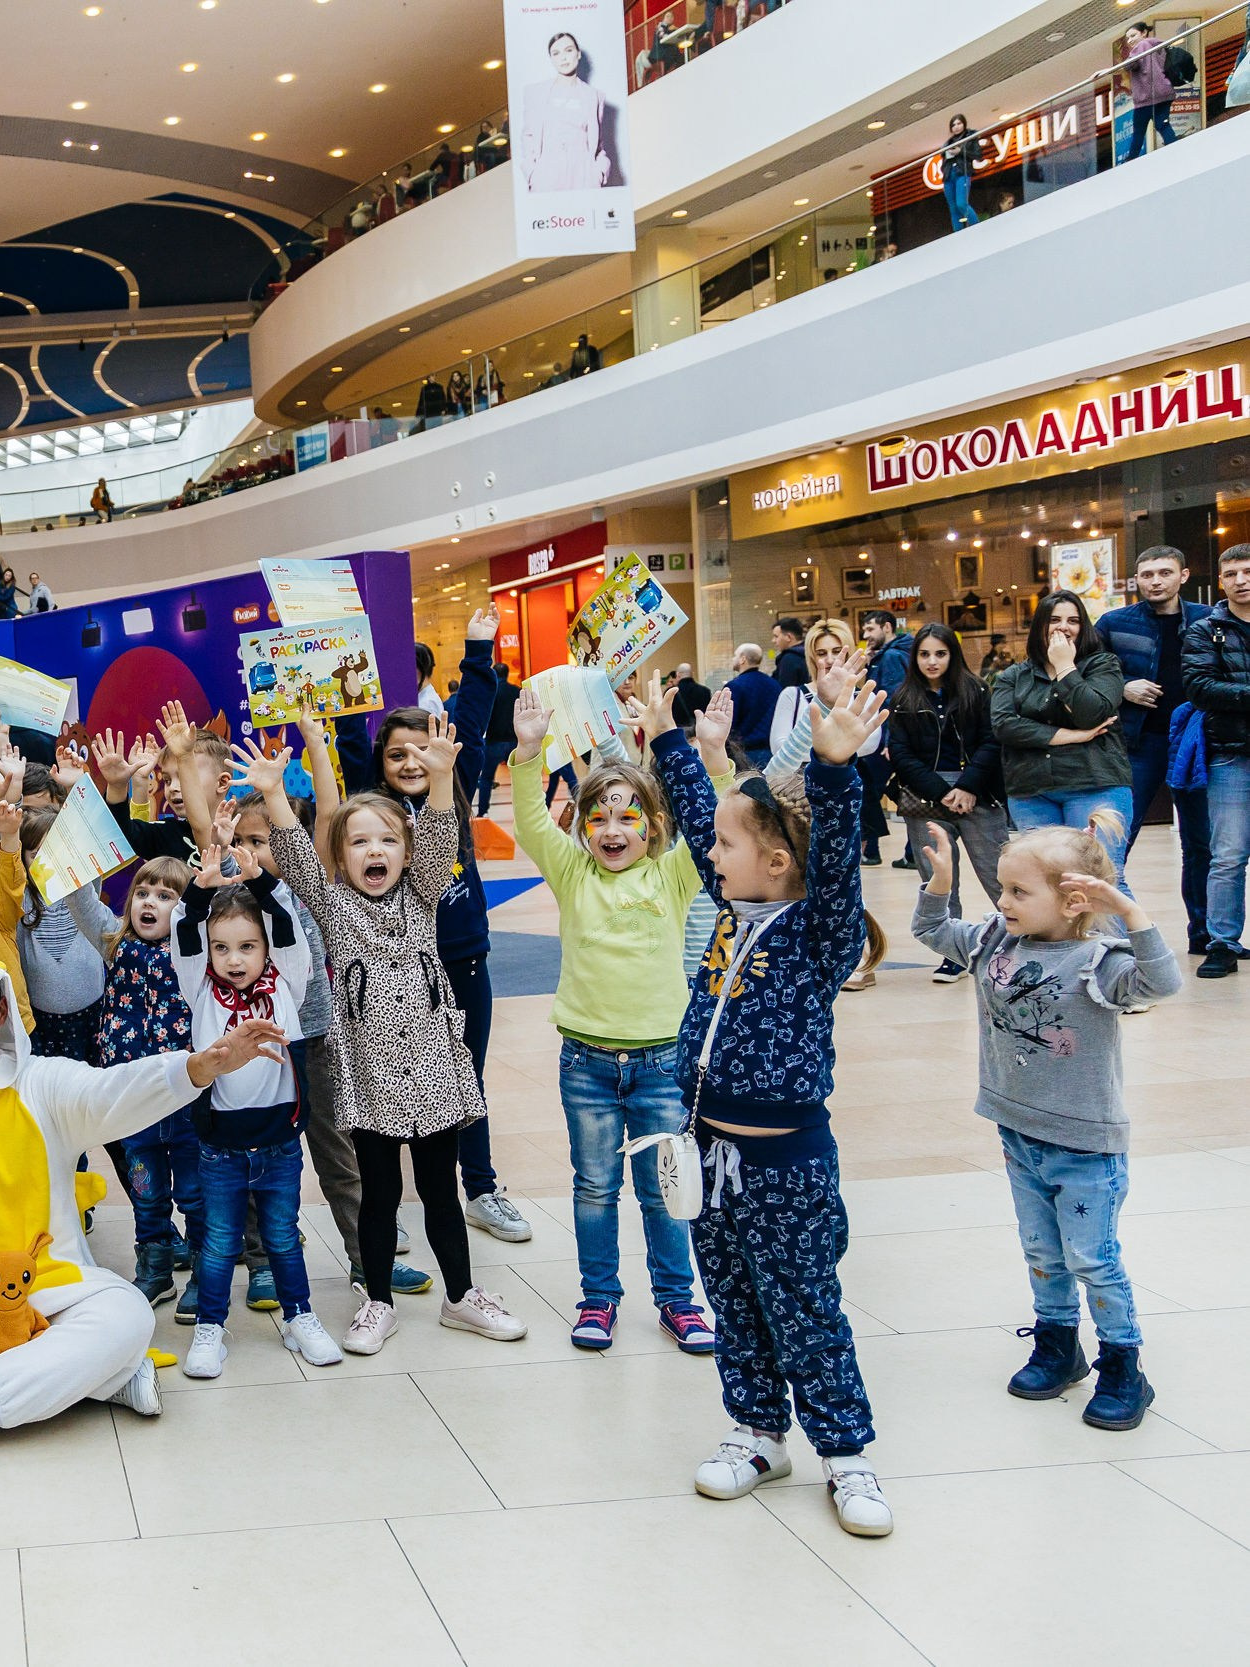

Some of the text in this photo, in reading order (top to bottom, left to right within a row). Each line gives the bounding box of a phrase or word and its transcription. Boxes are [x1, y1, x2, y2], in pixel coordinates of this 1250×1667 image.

[532, 215, 586, 230] re:Store
[866, 363, 1250, 494] ШОКОЛАДНИЦ
[751, 472, 842, 511] кофейня
[877, 586, 921, 600] ЗАВТРАК
[235, 607, 258, 622] Рыжий
[269, 636, 348, 659] РАСКРАСКА
